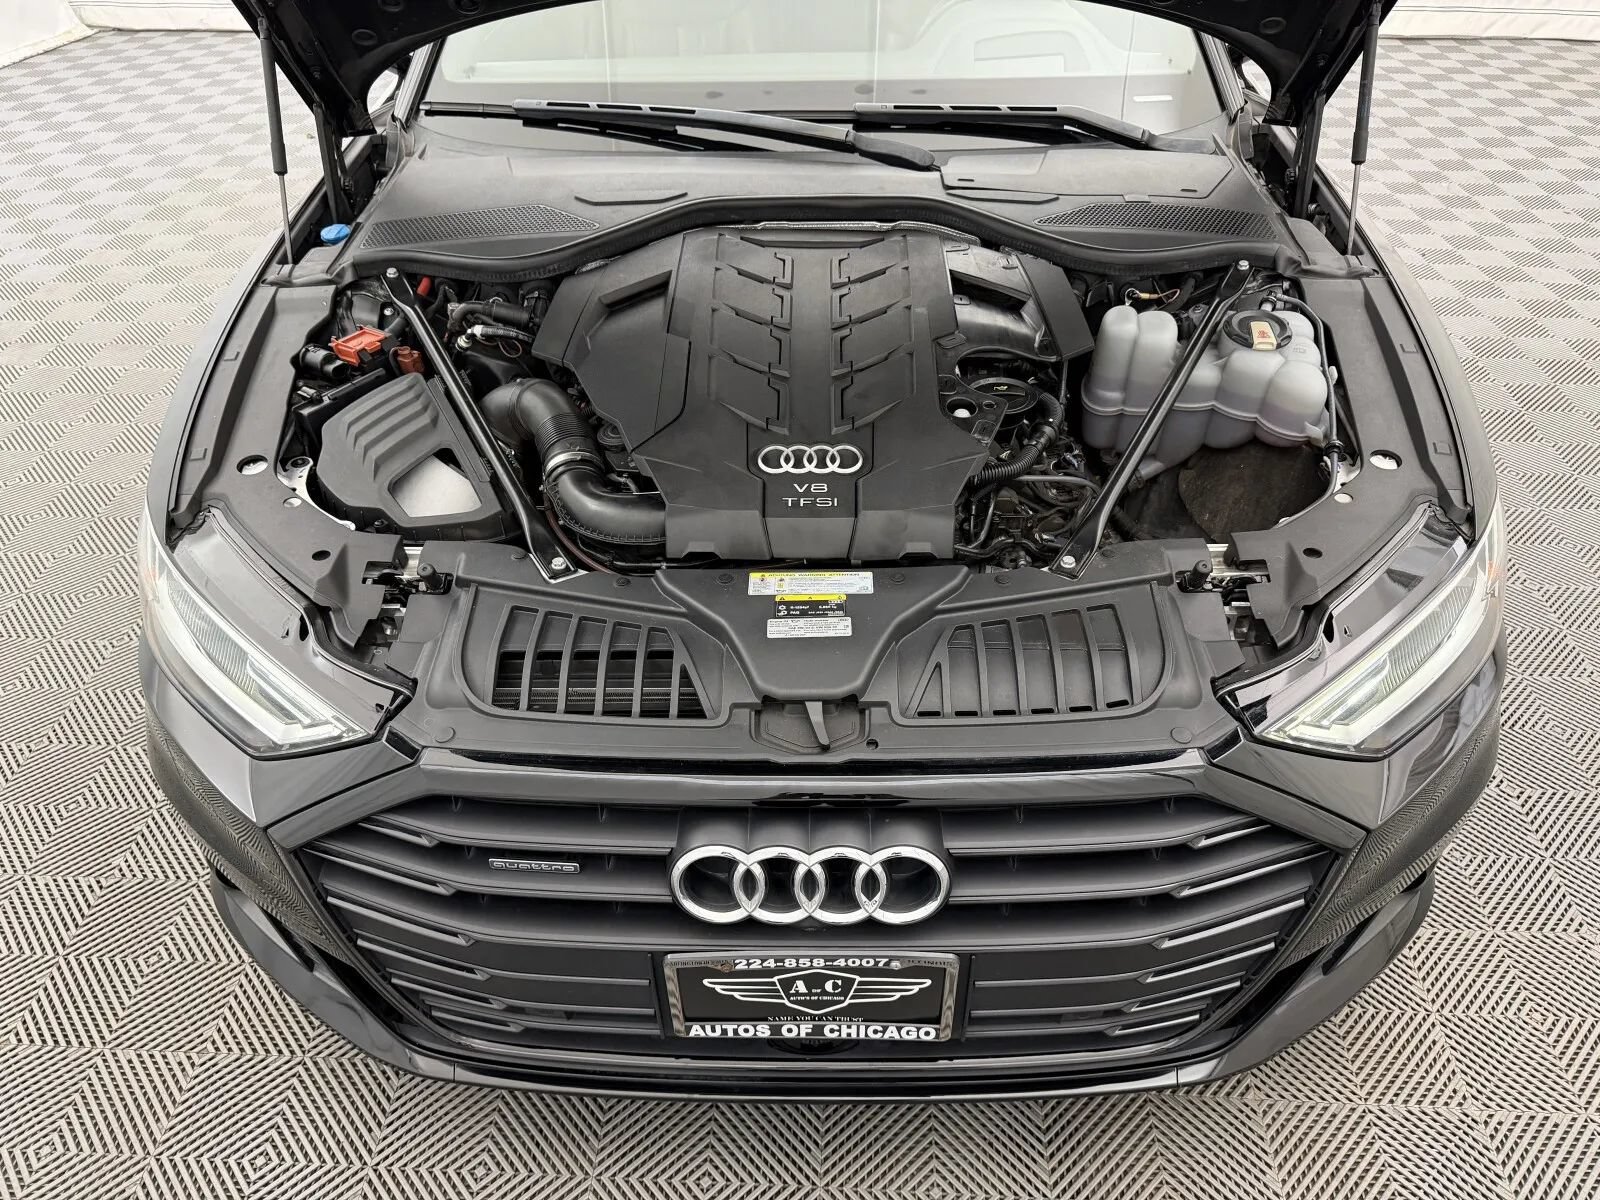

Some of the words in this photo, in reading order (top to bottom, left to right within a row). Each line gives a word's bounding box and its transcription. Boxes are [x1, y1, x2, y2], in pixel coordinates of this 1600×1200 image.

[793, 483, 828, 493] V8
[782, 497, 838, 507] TFSI
[493, 862, 575, 872] quattro
[734, 958, 889, 970] 224-858-4007
[789, 980, 809, 994] A
[824, 979, 842, 993] C
[688, 1024, 771, 1038] AUTOS
[781, 1024, 813, 1038] OF
[823, 1024, 936, 1040] CHICAGO
